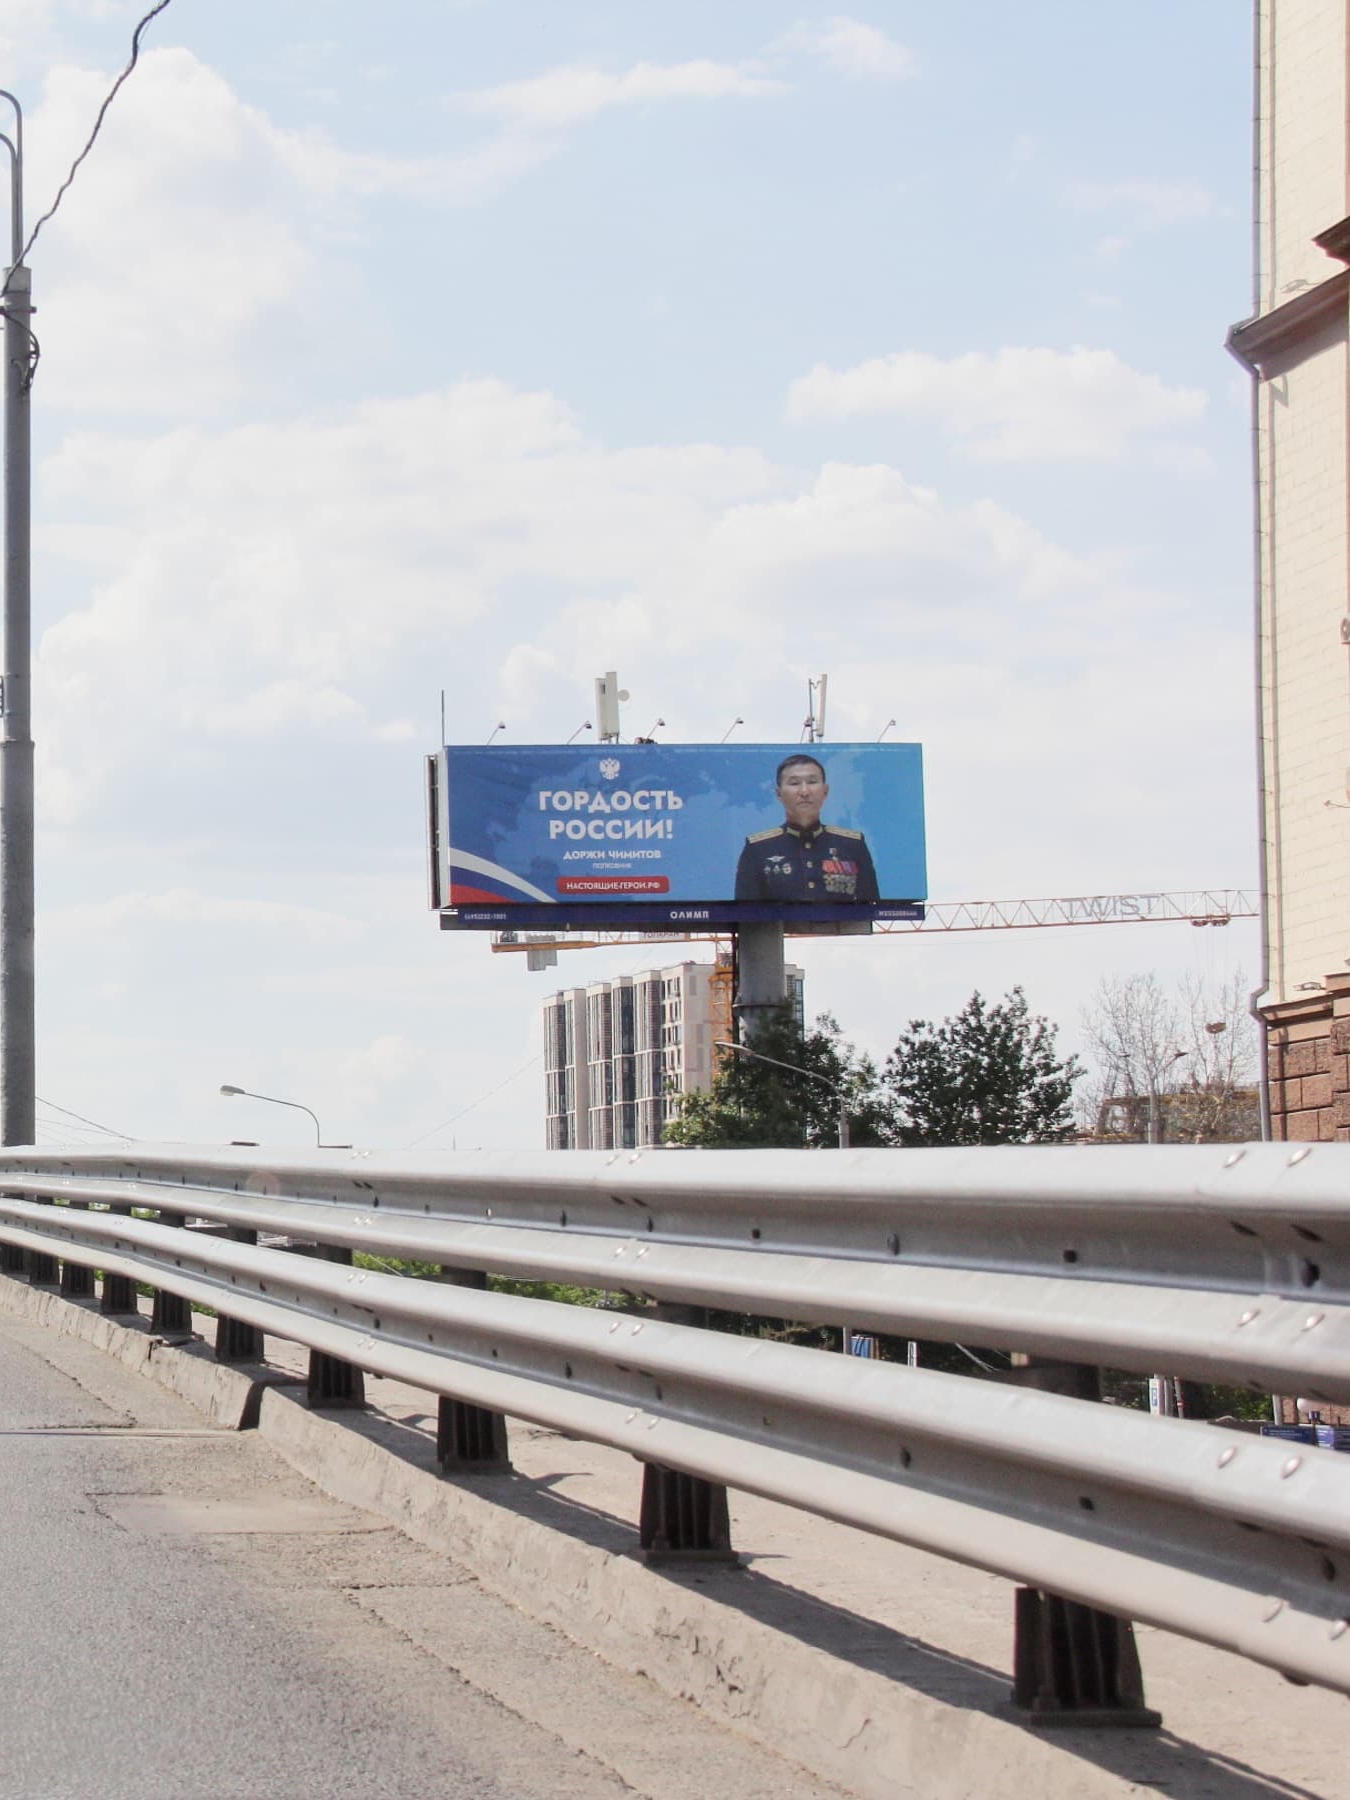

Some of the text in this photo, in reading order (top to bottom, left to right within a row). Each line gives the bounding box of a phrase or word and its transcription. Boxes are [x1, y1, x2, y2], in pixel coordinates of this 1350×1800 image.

[538, 789, 683, 813] ГОРДОСТЬ
[549, 819, 674, 840] РОССИИ!
[563, 850, 662, 860] ДОРЖИ ЧИМИТОВ
[670, 911, 709, 919] ОЛИМП
[1062, 894, 1164, 918] TWIST
